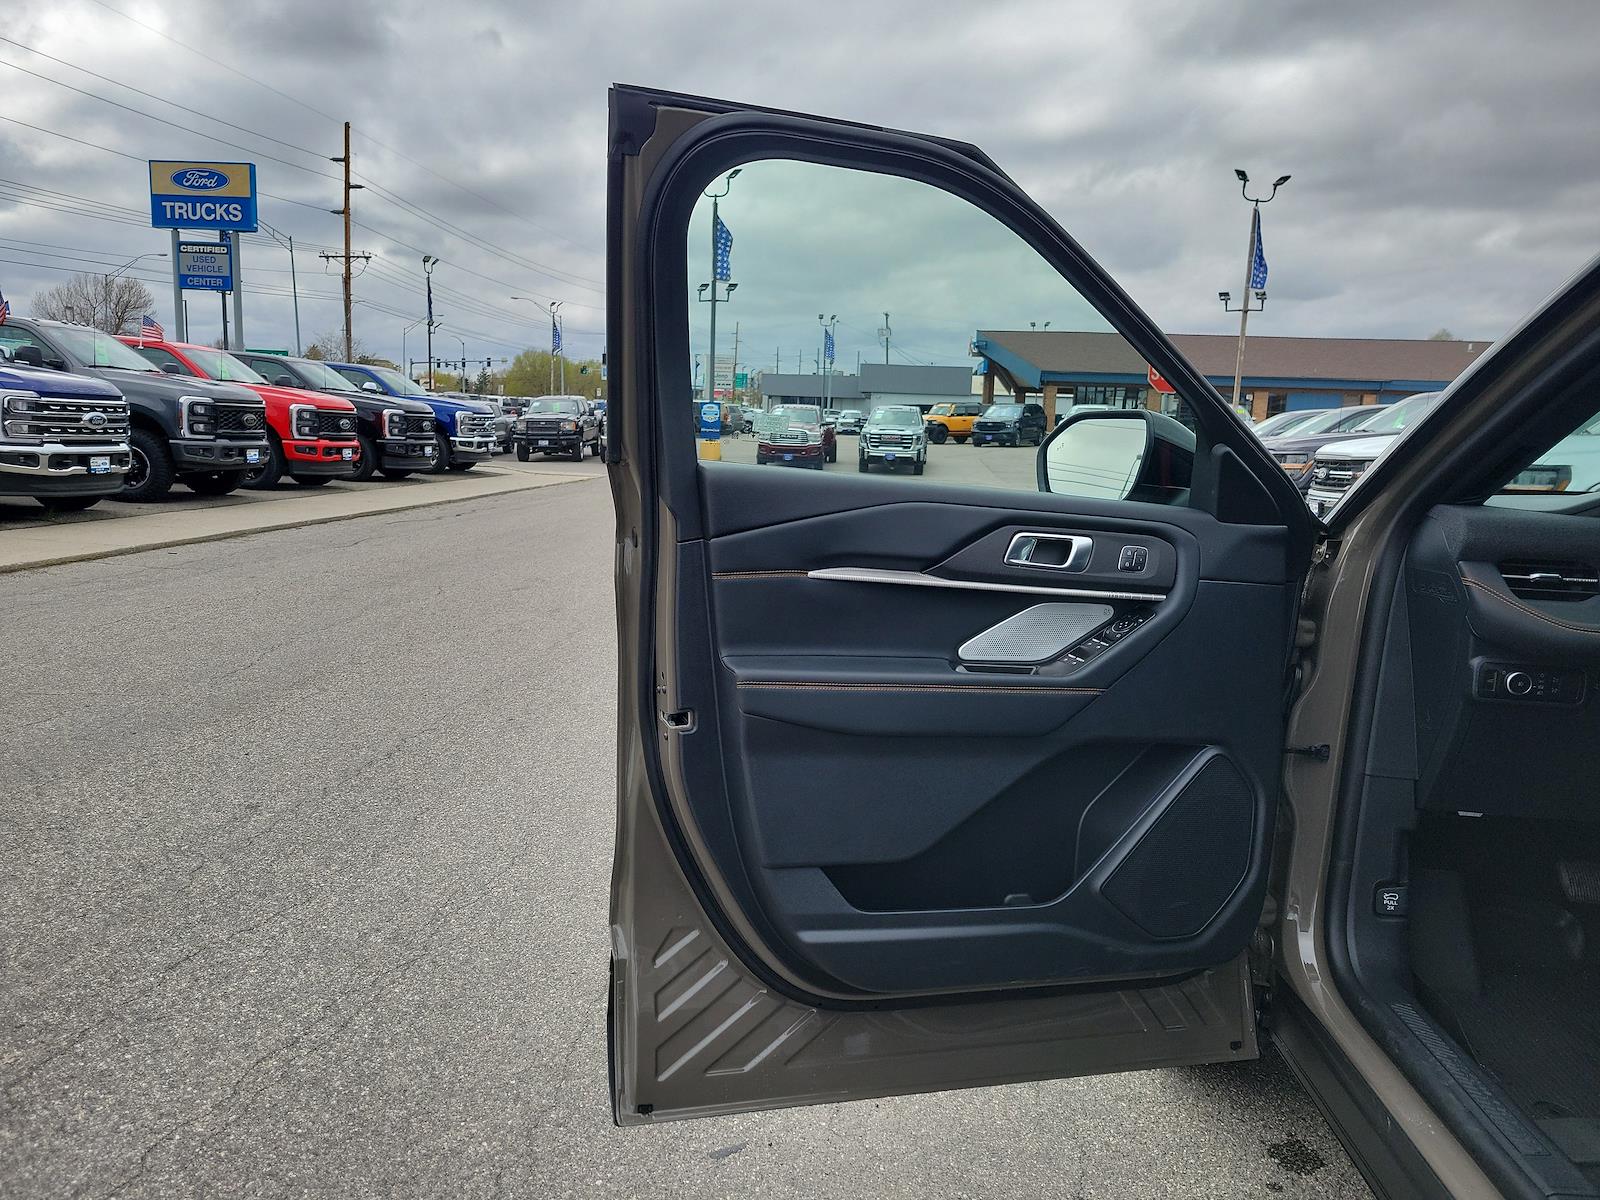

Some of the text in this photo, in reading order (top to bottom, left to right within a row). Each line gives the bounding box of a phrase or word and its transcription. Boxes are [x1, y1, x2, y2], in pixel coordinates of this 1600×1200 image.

[183, 170, 218, 188] Ford
[162, 202, 243, 222] TRUCKS
[180, 245, 228, 254] CERTIFIED
[192, 255, 217, 264] USED
[186, 265, 224, 273] VEHICLE
[187, 277, 223, 287] CENTER
